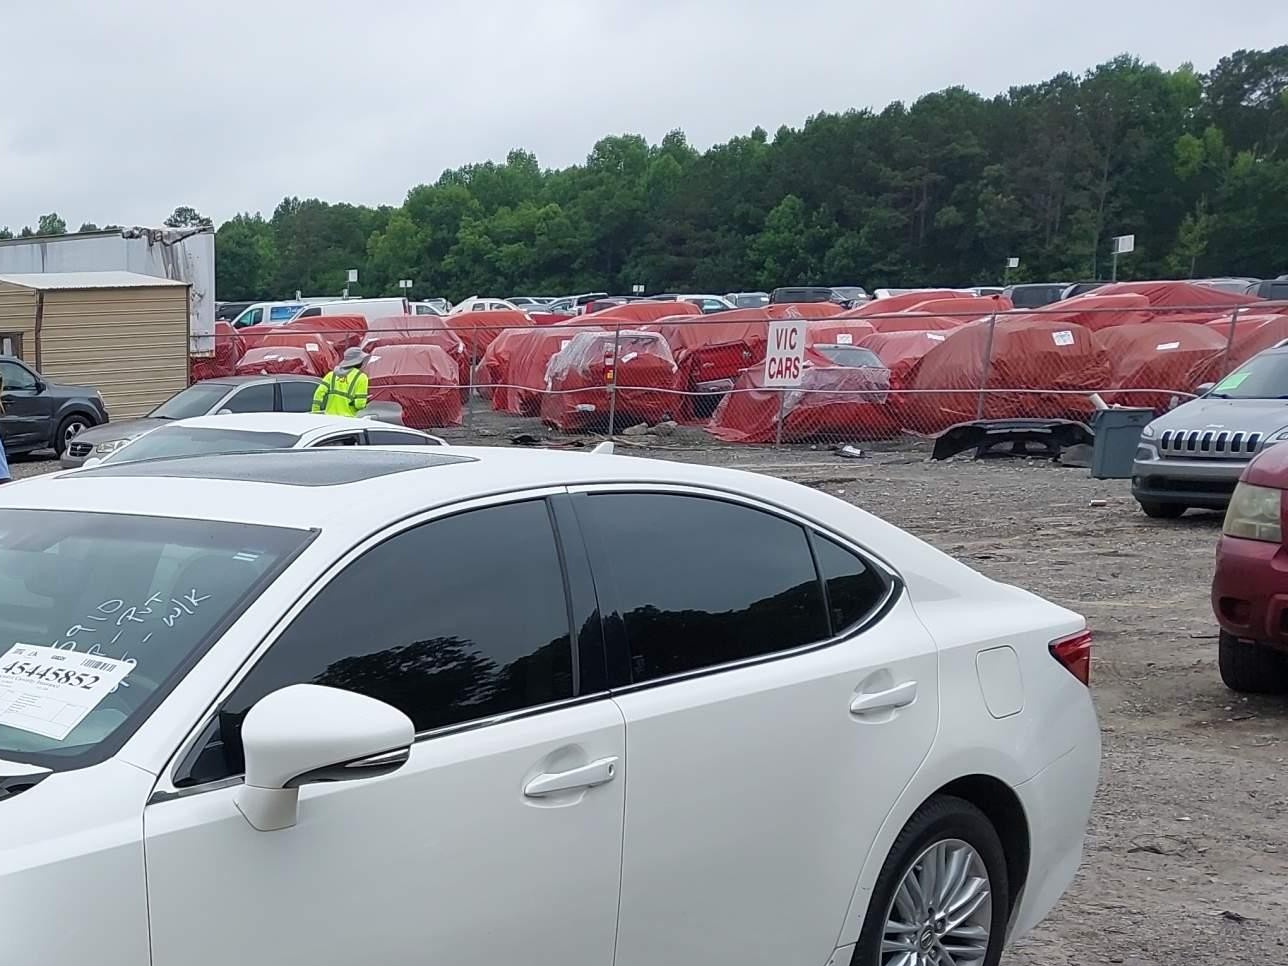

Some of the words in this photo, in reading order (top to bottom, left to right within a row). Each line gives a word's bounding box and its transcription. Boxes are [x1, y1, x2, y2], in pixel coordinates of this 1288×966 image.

[775, 327, 798, 351] VIC
[768, 356, 801, 380] CARS
[2, 660, 100, 690] 45445852
